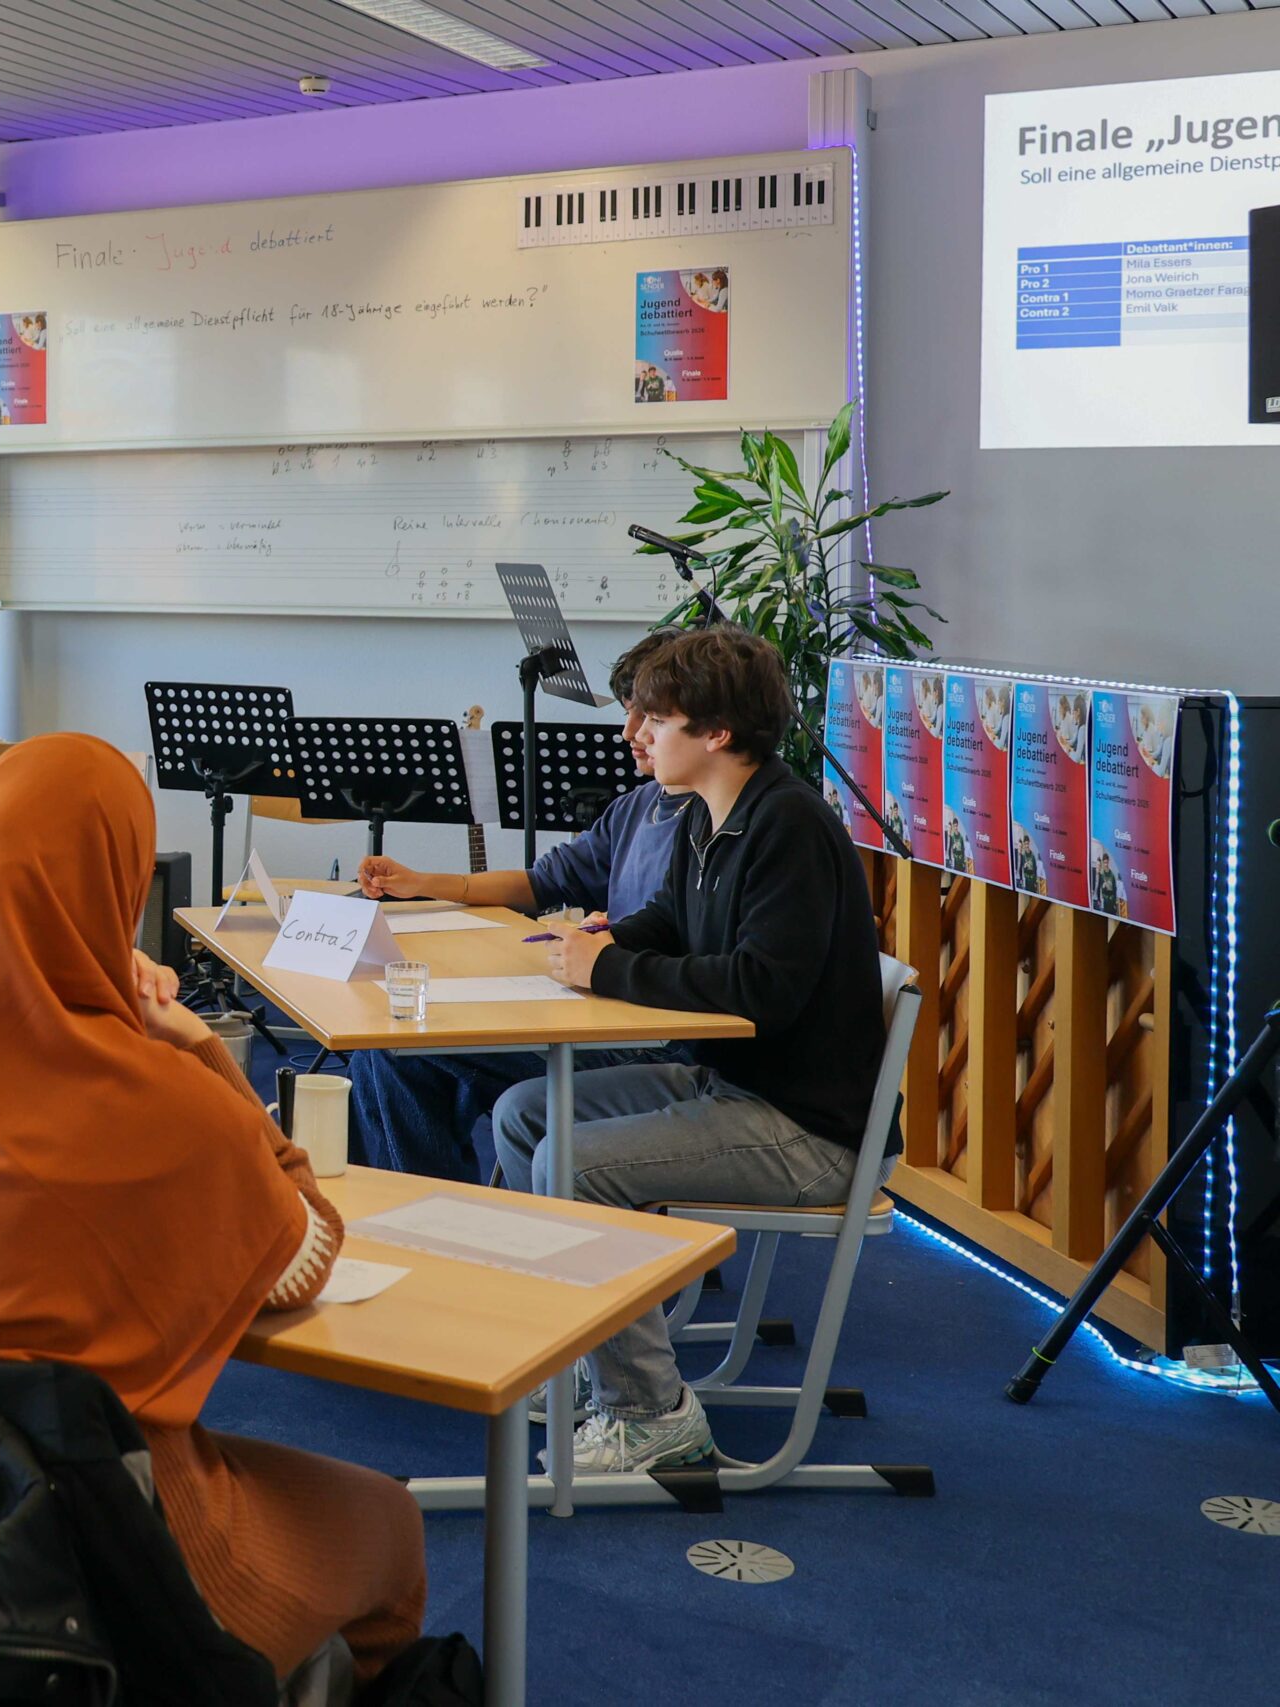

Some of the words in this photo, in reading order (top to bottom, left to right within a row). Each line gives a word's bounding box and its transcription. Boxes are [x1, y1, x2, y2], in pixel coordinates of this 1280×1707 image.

[1018, 118, 1133, 156] Finale
[1020, 167, 1052, 185] Soll
[1057, 167, 1096, 183] eine
[1102, 160, 1204, 182] allgemeine
[1020, 264, 1040, 275] Pro
[1043, 263, 1050, 273] 1
[1126, 258, 1151, 269] Mila
[1153, 257, 1192, 268] Essers
[1020, 279, 1040, 290] Pro
[1042, 278, 1050, 289] 2
[1126, 273, 1152, 285] Jona
[1155, 271, 1199, 283] Weirich
[1020, 293, 1060, 304] Contra
[1063, 292, 1069, 303] 1
[1126, 289, 1163, 300] Momo
[1165, 286, 1215, 298] Graetzer
[640, 298, 681, 310] Jugend
[1126, 303, 1151, 314] Emil
[190, 308, 275, 331] Dienstpflicht
[289, 304, 313, 325] für
[640, 309, 693, 320] debattiert
[1020, 307, 1061, 319] Contra
[1062, 306, 1070, 317] 2
[829, 698, 853, 713] Jugend
[828, 714, 860, 729] debattiert
[888, 707, 913, 723] Jugend
[887, 723, 920, 739] debattiert
[947, 716, 975, 734] Jugend
[947, 734, 983, 751] debattiert
[1017, 728, 1048, 746] Jugend
[1096, 738, 1129, 758] Jugend
[1017, 747, 1057, 765] debattiert
[1095, 759, 1140, 778] debattiert
[962, 796, 976, 808] Qualis
[913, 814, 927, 826] Finale
[1033, 811, 1050, 824] Qualis
[975, 831, 990, 843] Finale
[1114, 828, 1131, 842] Qualis
[1049, 849, 1066, 862] Finale
[1130, 869, 1148, 882] Finale
[281, 919, 339, 947] Contra
[340, 929, 359, 952] 2
